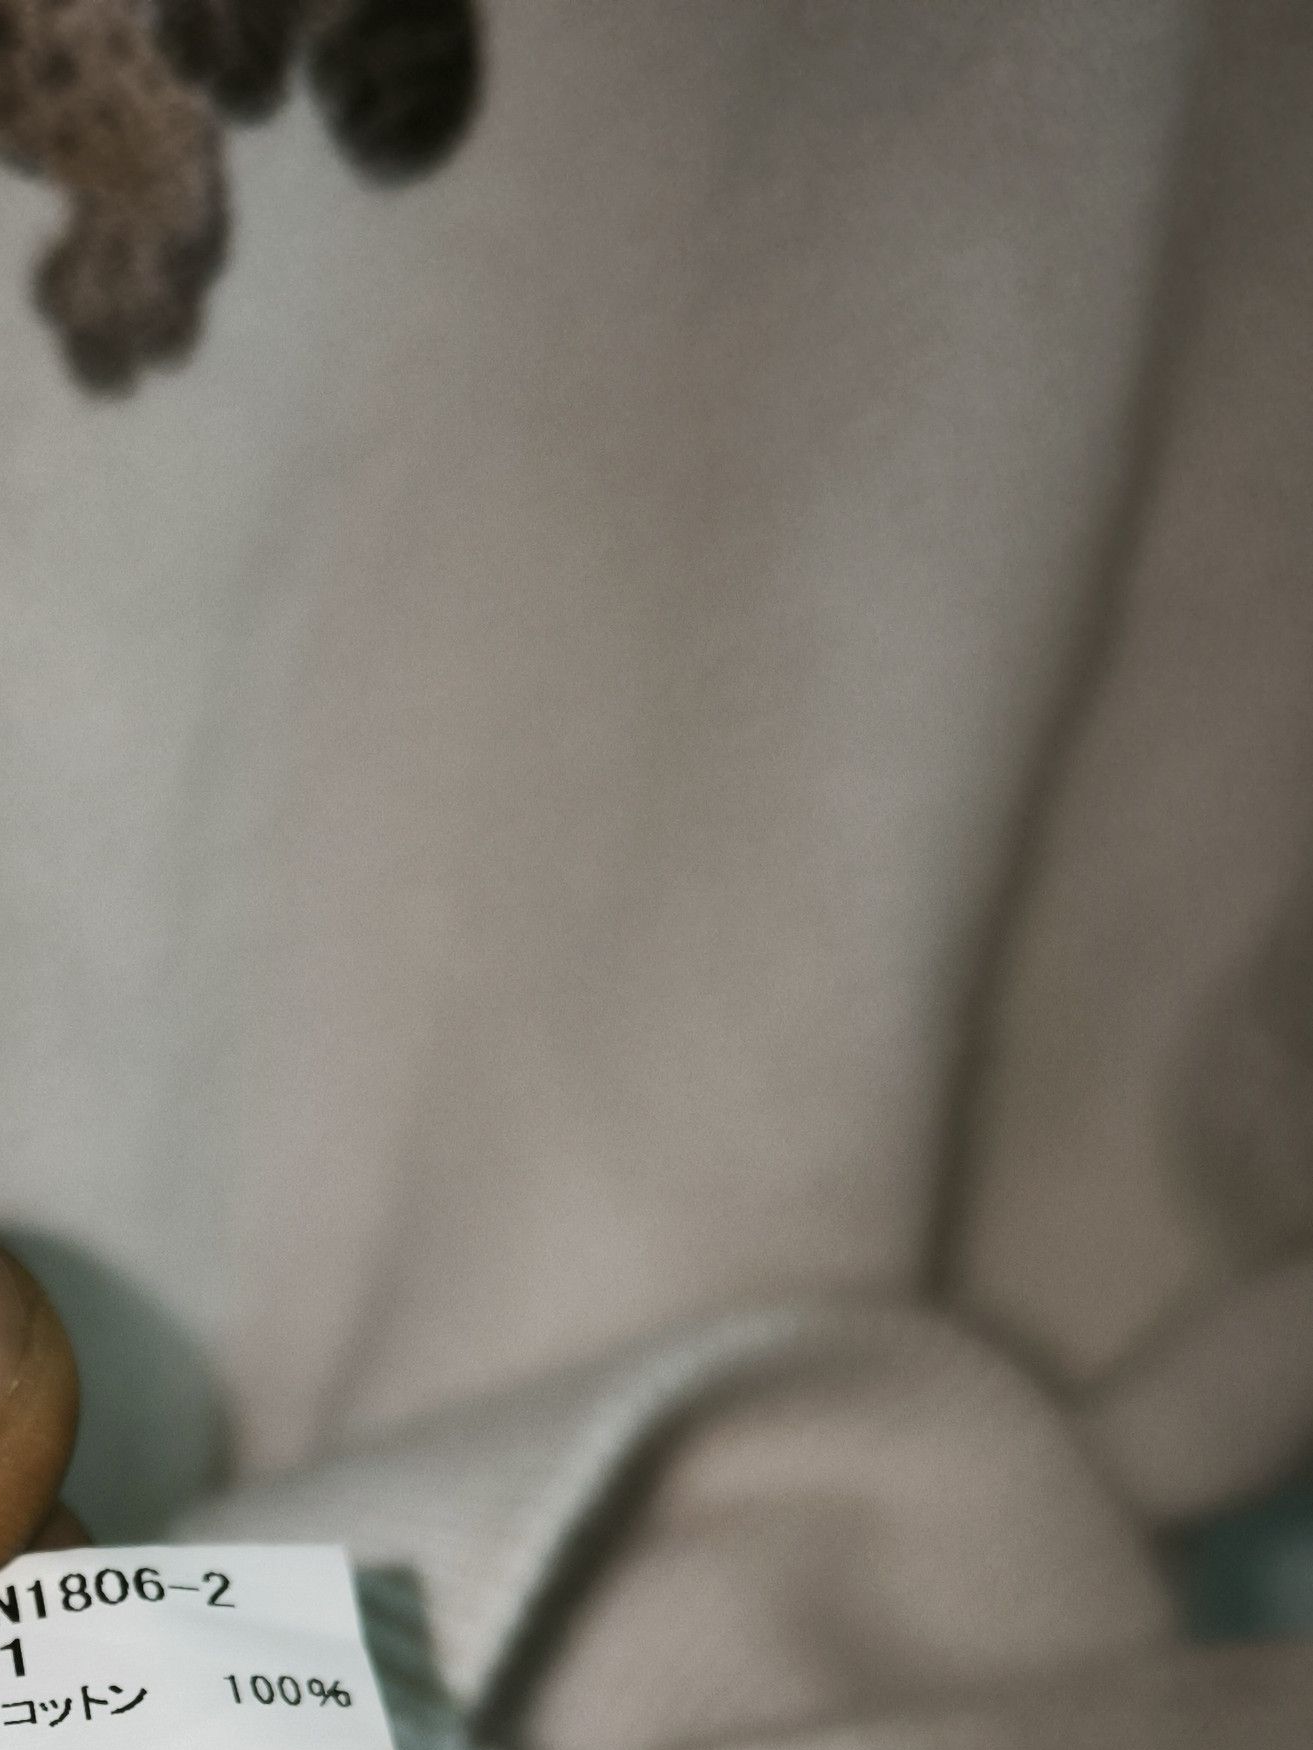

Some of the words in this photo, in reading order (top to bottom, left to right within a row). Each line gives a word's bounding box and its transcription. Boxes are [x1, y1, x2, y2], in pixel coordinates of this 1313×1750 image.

[0, 1638, 26, 1677] 1
[1, 1684, 147, 1727] コットン
[223, 1674, 352, 1708] 100%
